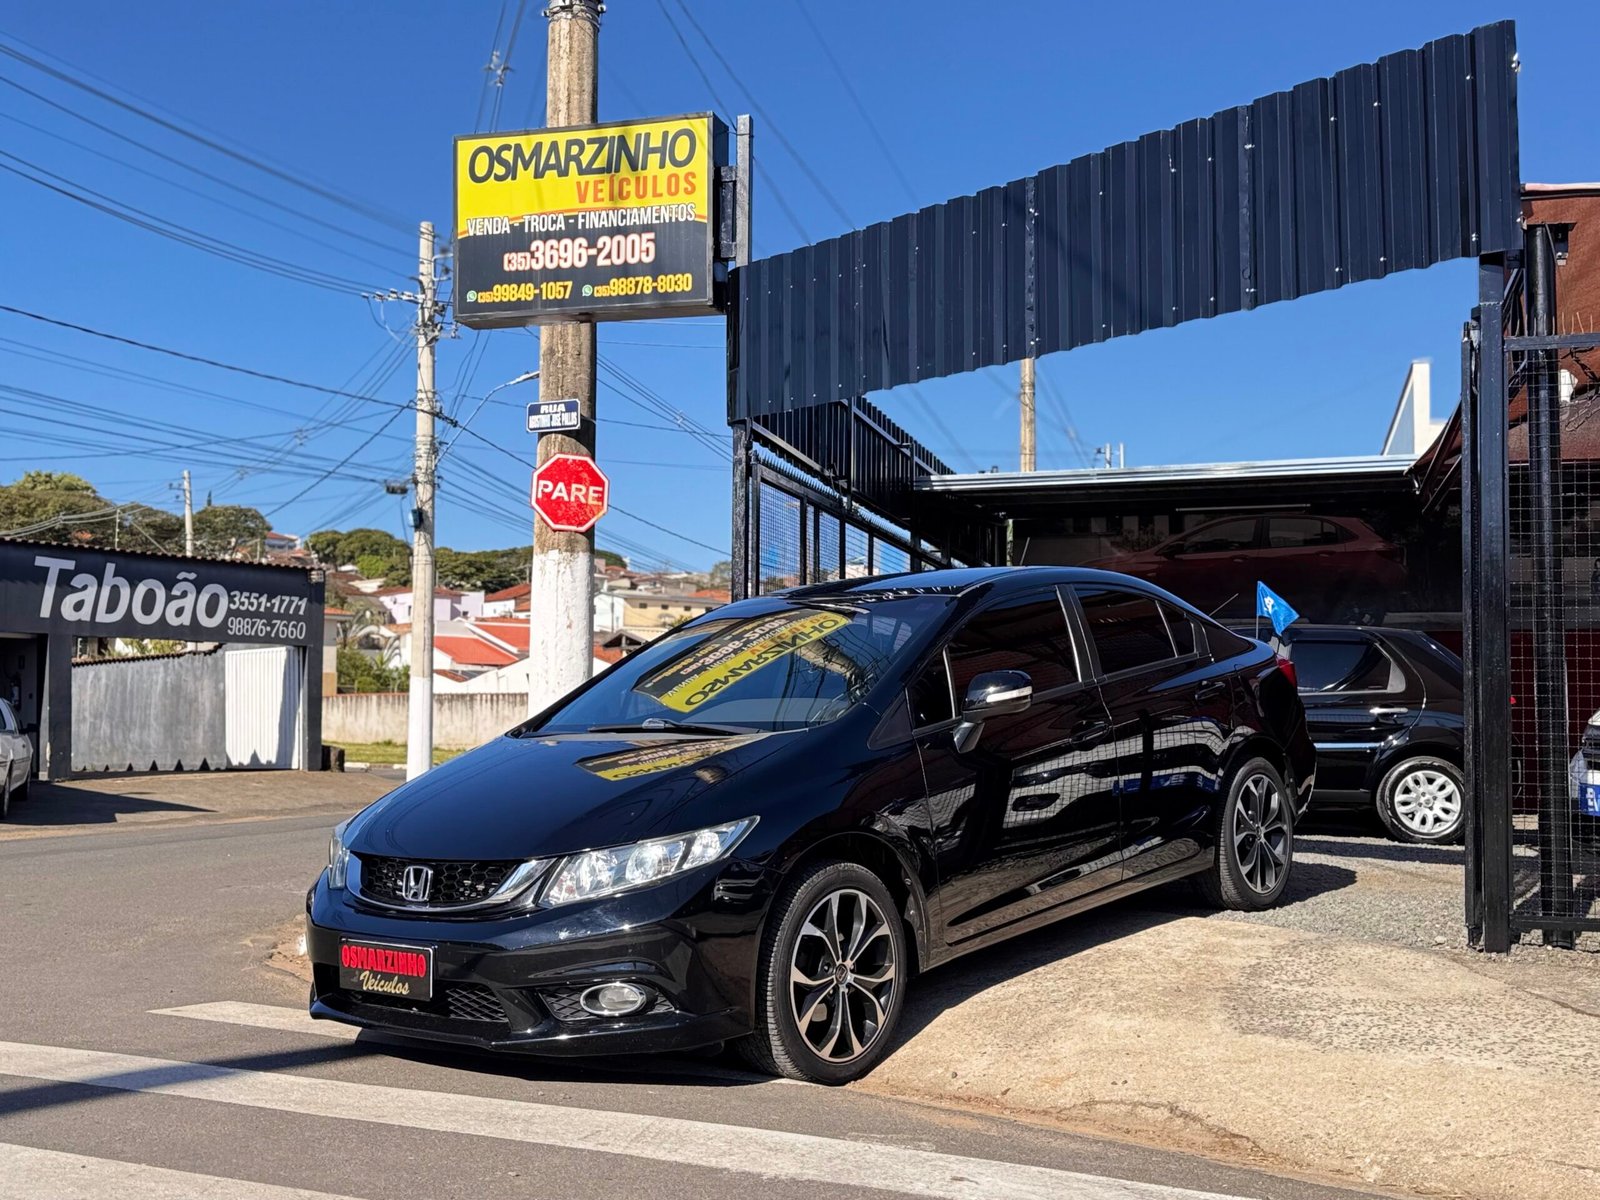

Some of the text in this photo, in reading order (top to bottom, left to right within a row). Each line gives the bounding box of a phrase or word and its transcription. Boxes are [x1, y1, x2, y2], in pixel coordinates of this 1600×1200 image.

[469, 128, 696, 183] OSMARZINHO
[576, 171, 696, 203] VEÍCULOS
[467, 217, 510, 236] VENDA
[523, 213, 565, 232] TROCA
[578, 203, 695, 229] FINANCIAMENTOS
[503, 232, 655, 271] (35)3696-2005
[541, 403, 565, 414] RUA
[538, 480, 603, 505] PARE
[34, 555, 229, 628] Taboão
[341, 945, 426, 978] OSMARZINHO
[360, 970, 410, 995] Veículos
